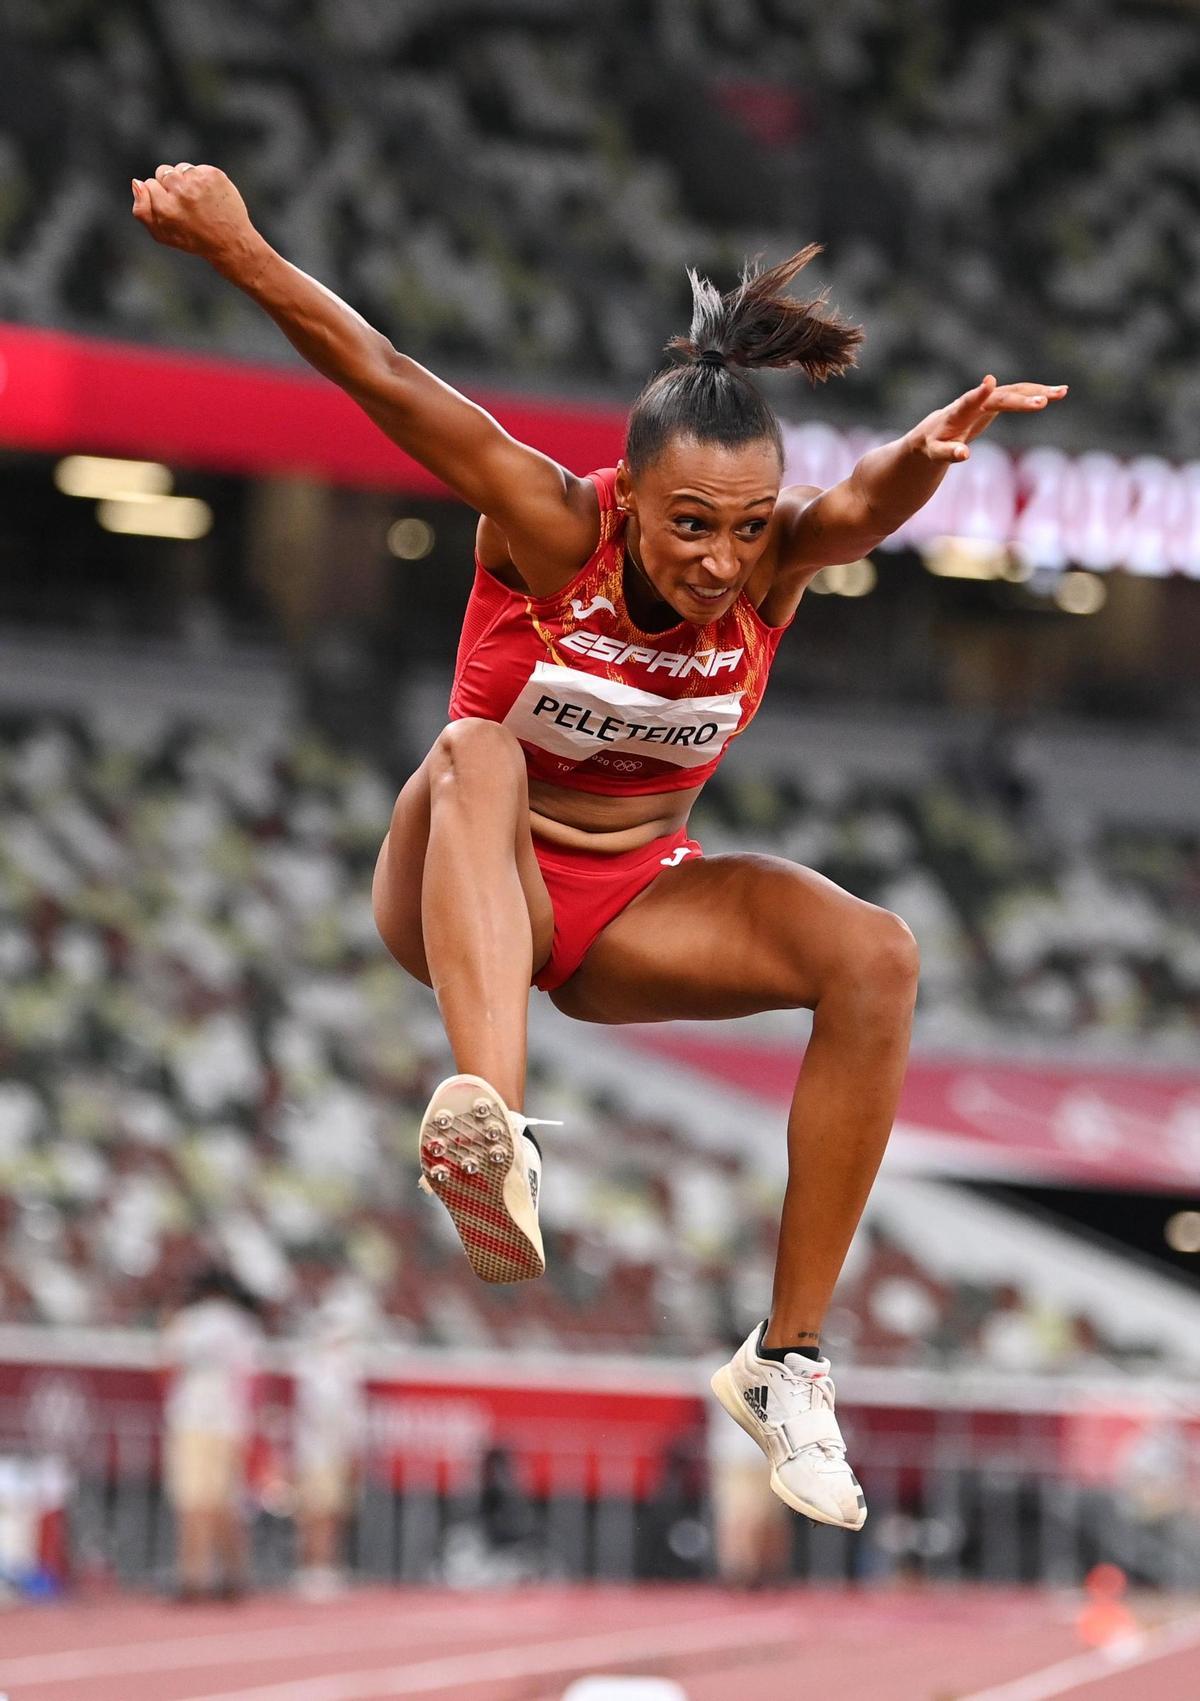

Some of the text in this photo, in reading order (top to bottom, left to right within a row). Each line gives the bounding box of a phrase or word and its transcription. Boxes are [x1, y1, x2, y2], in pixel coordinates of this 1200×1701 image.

[558, 629, 745, 678] ESPAÑA
[532, 694, 719, 747] PELETEIRO
[743, 1391, 768, 1423] adidas
